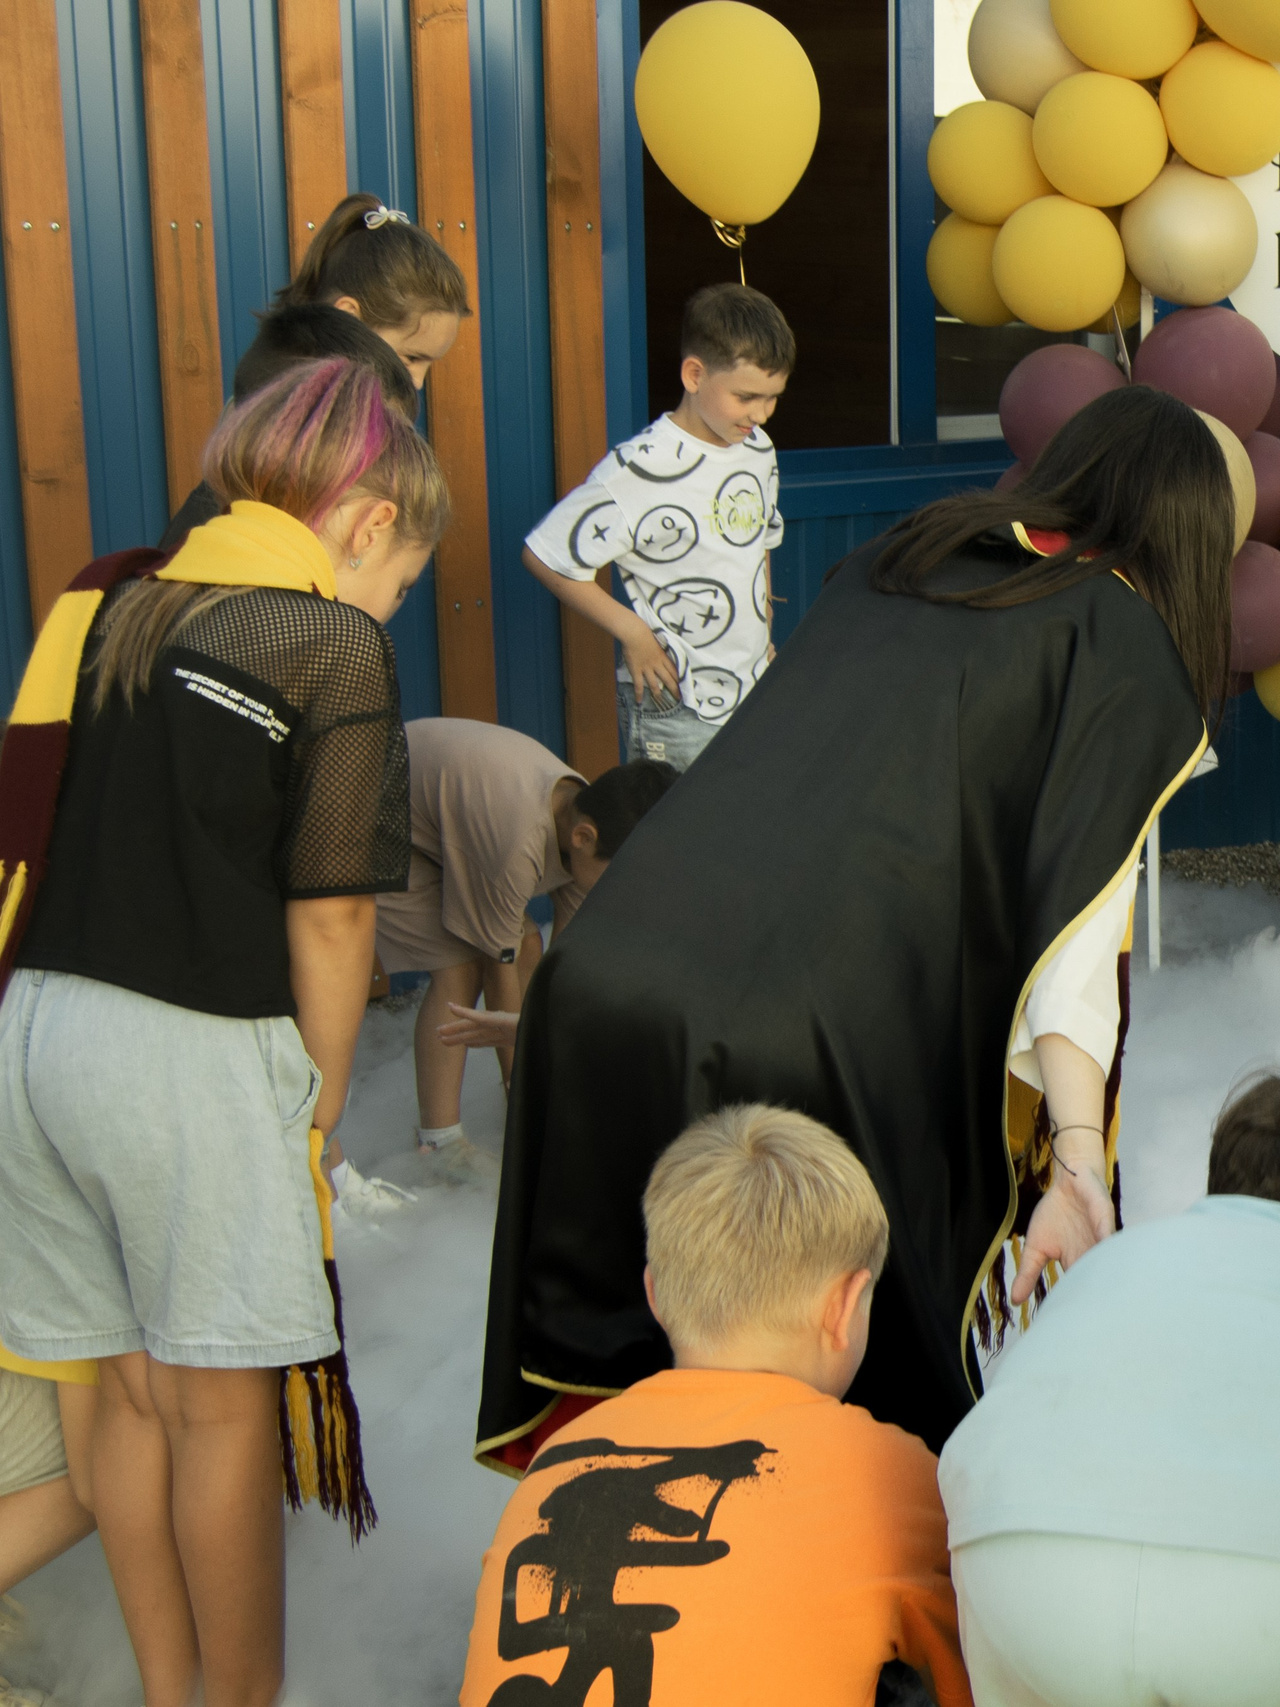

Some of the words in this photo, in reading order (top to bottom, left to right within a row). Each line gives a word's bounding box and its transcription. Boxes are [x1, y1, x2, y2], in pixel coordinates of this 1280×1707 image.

[174, 667, 191, 679] THE
[190, 672, 229, 694] SECRET
[227, 689, 245, 701] OF
[244, 696, 268, 714] YOUR
[186, 681, 198, 692] IS
[196, 686, 239, 712] HIDDEN
[238, 706, 250, 718] IN
